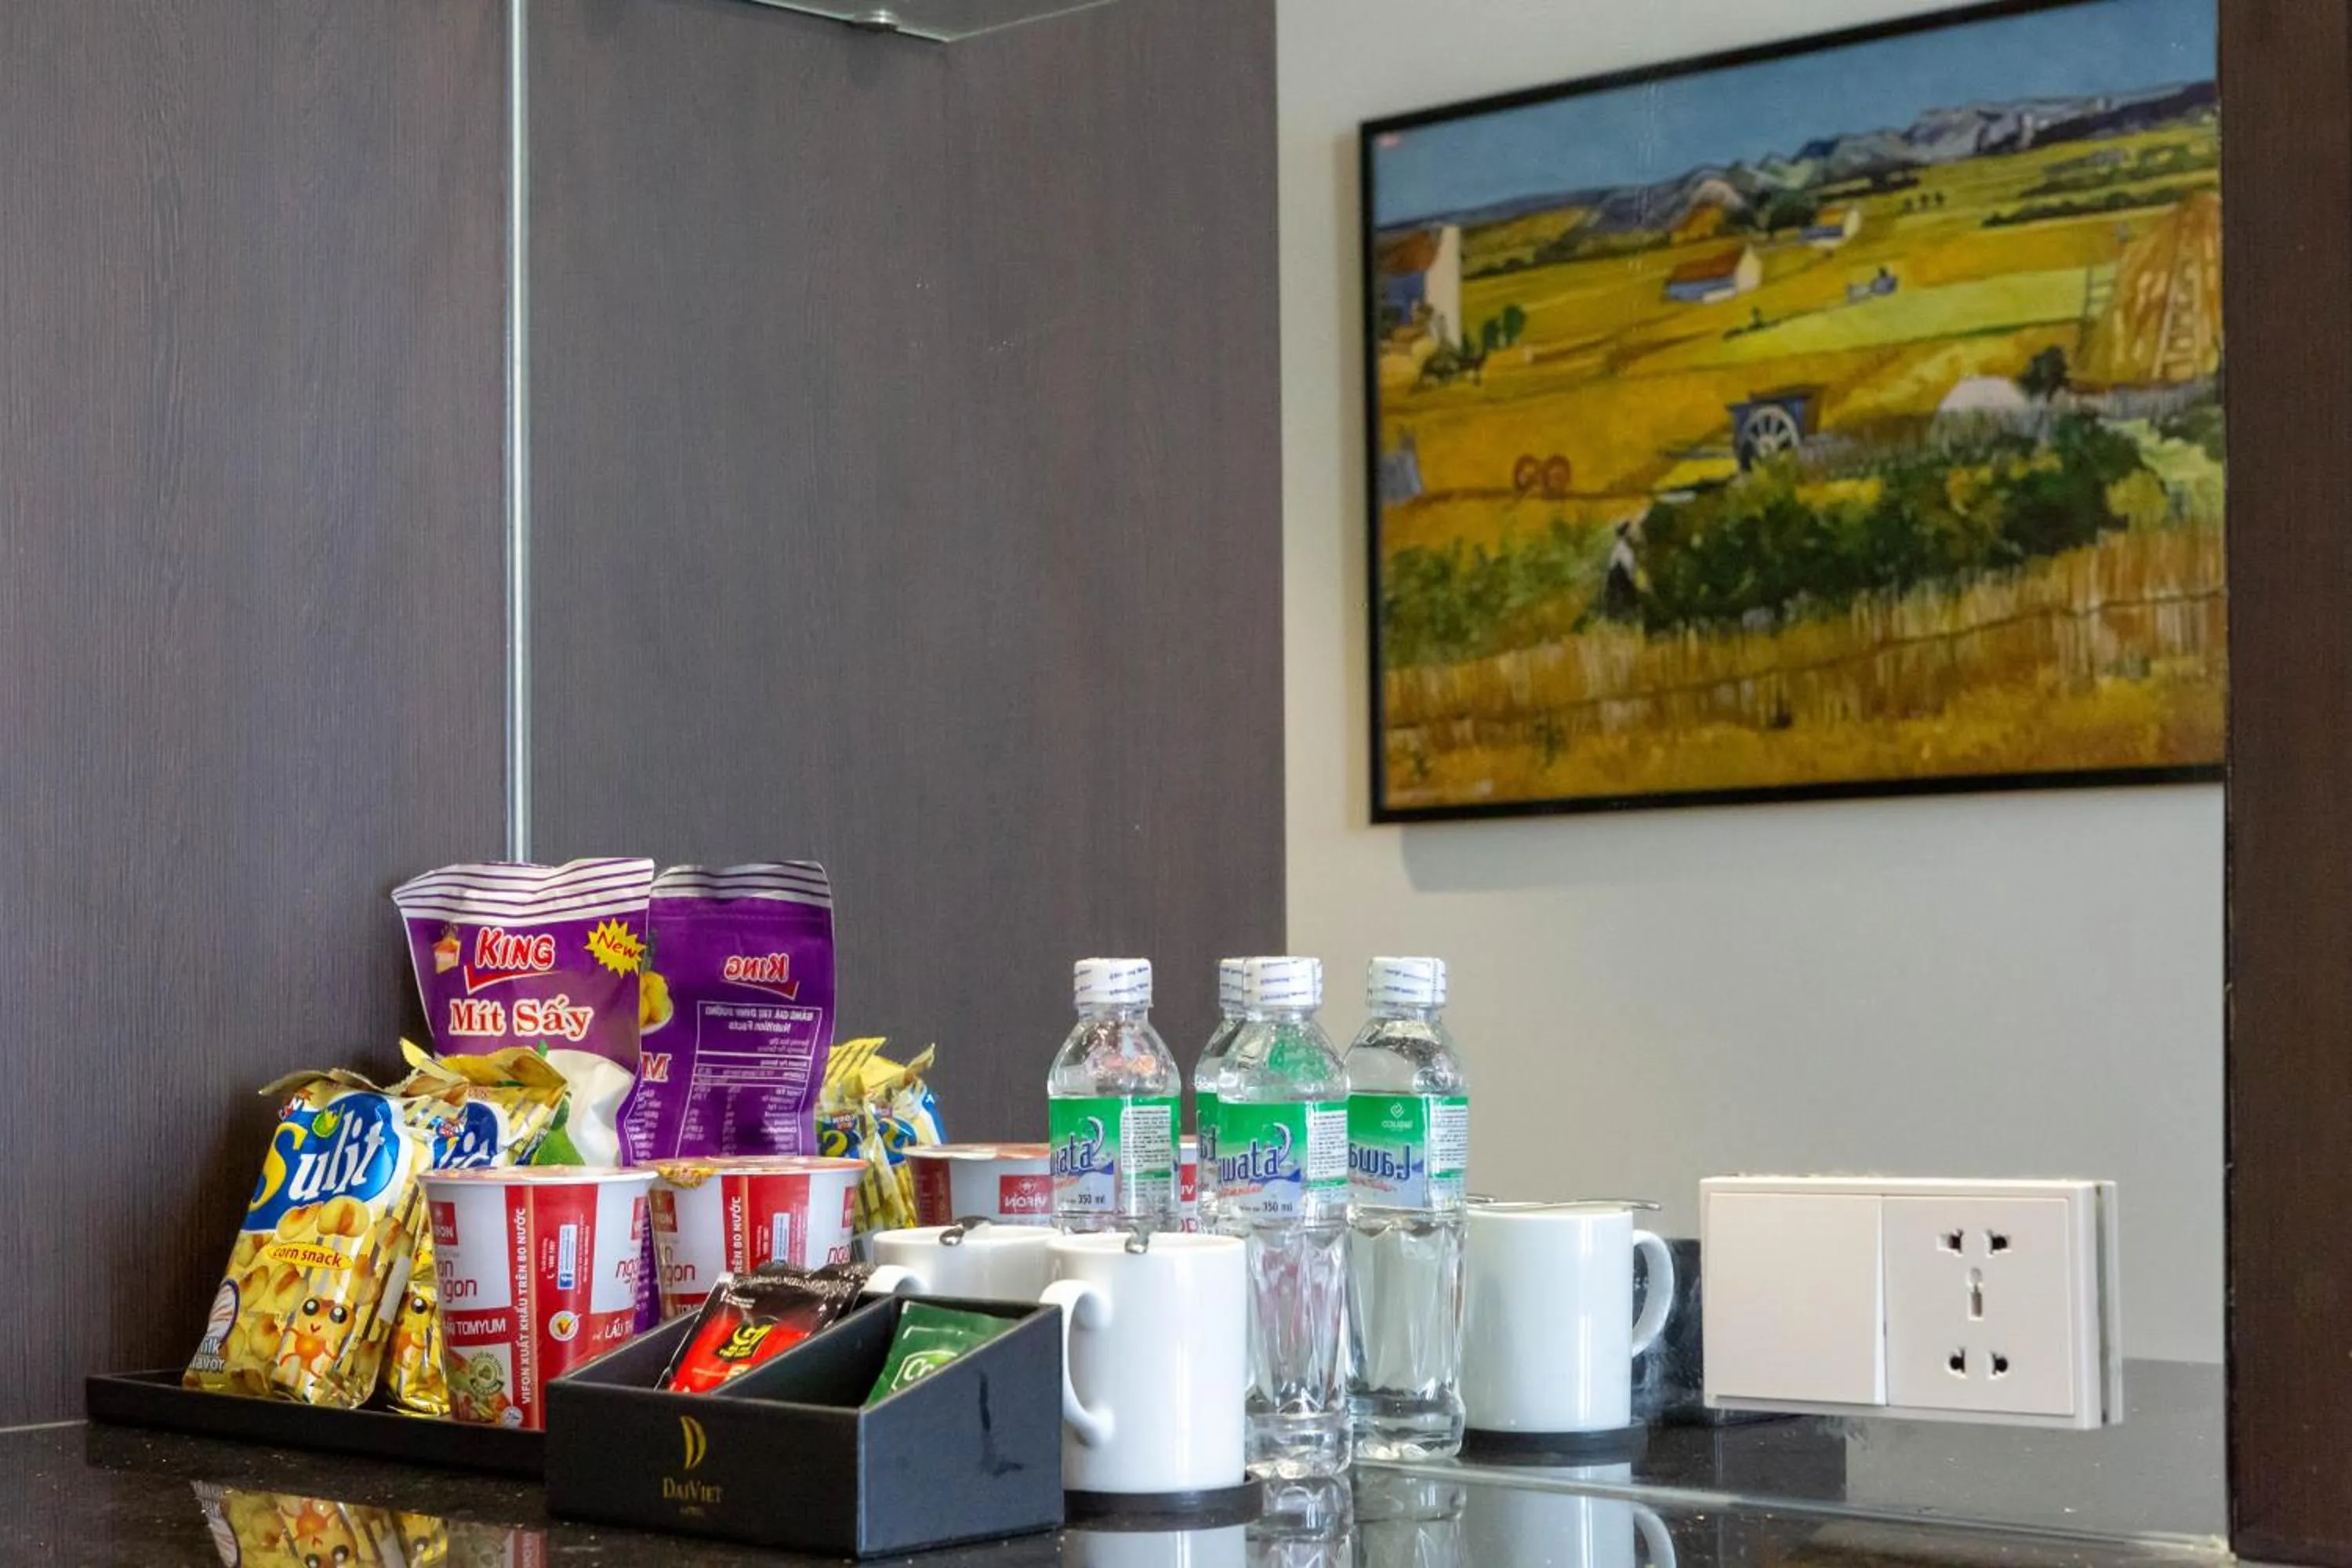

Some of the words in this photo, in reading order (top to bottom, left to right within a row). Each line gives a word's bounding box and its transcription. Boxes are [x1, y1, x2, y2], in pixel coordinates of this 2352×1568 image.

[476, 927, 554, 970] KING
[596, 931, 637, 959] New
[448, 999, 506, 1036] Mít
[514, 993, 594, 1041] Sấy
[249, 1110, 385, 1211] Sulit
[1218, 1140, 1279, 1184] wata
[273, 1247, 298, 1258] corn
[301, 1250, 342, 1268] snack
[731, 1250, 743, 1274] RÊN
[515, 1264, 528, 1295] TRÊN
[457, 1319, 506, 1335] TOMYUM
[520, 1367, 531, 1404] VIFON
